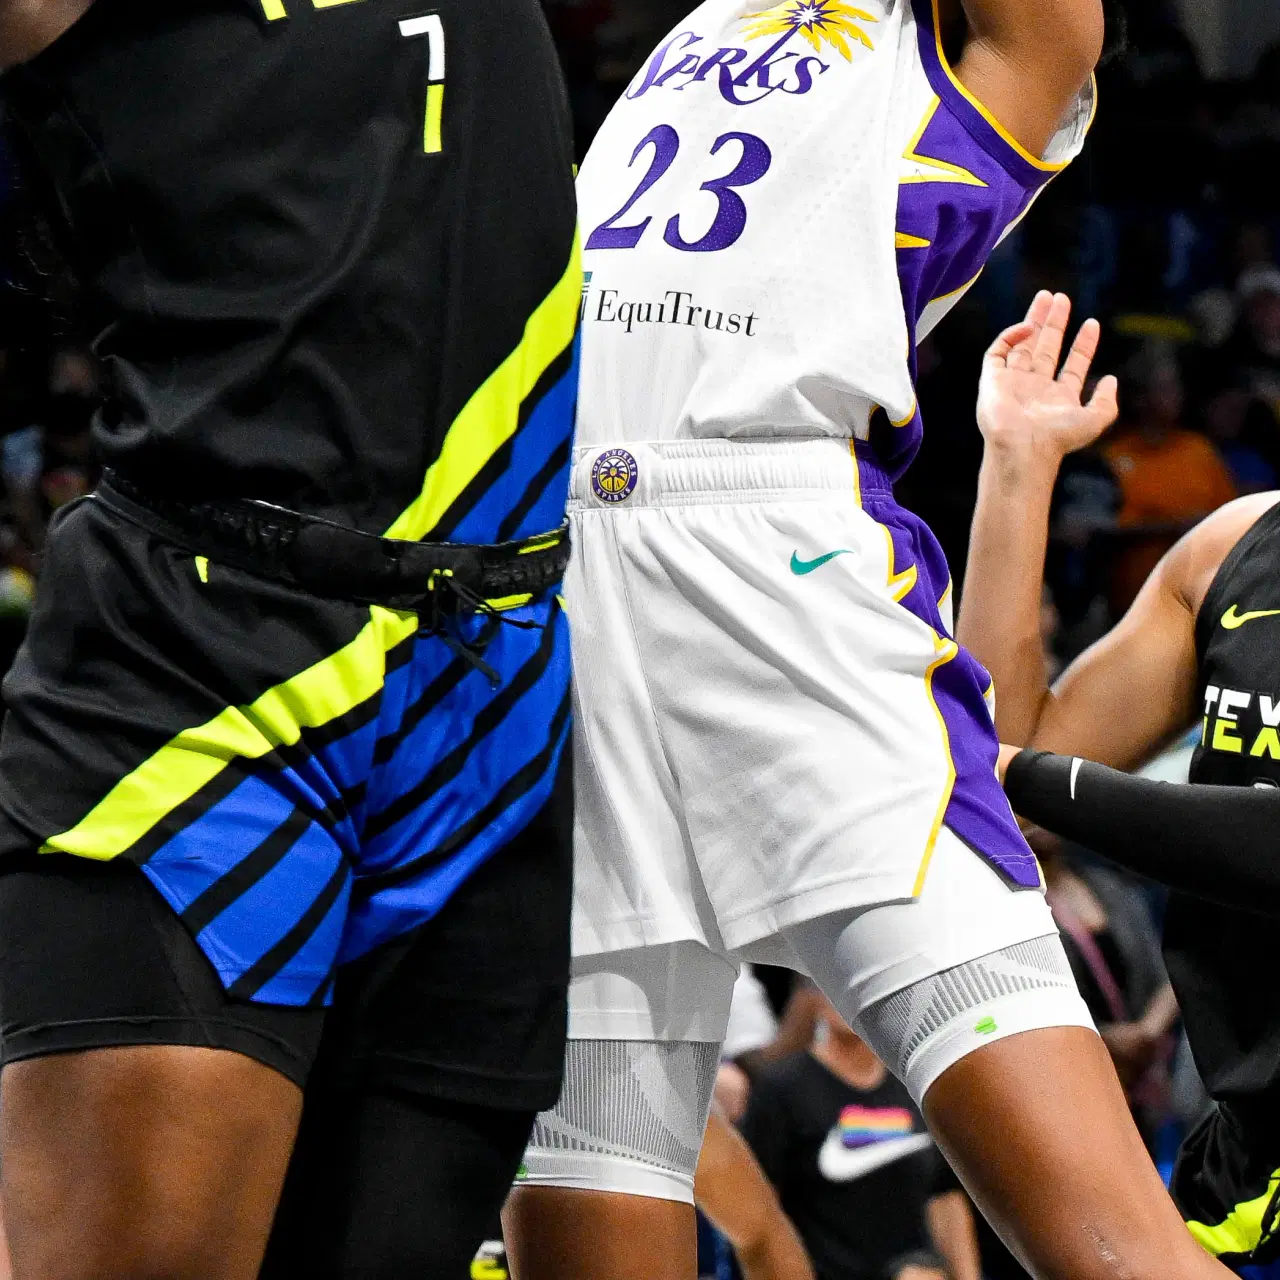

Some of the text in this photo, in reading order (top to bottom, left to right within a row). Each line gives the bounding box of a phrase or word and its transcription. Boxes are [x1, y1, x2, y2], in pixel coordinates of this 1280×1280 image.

[399, 14, 445, 153] 7
[584, 124, 772, 252] 23
[594, 290, 760, 337] EquiTrust
